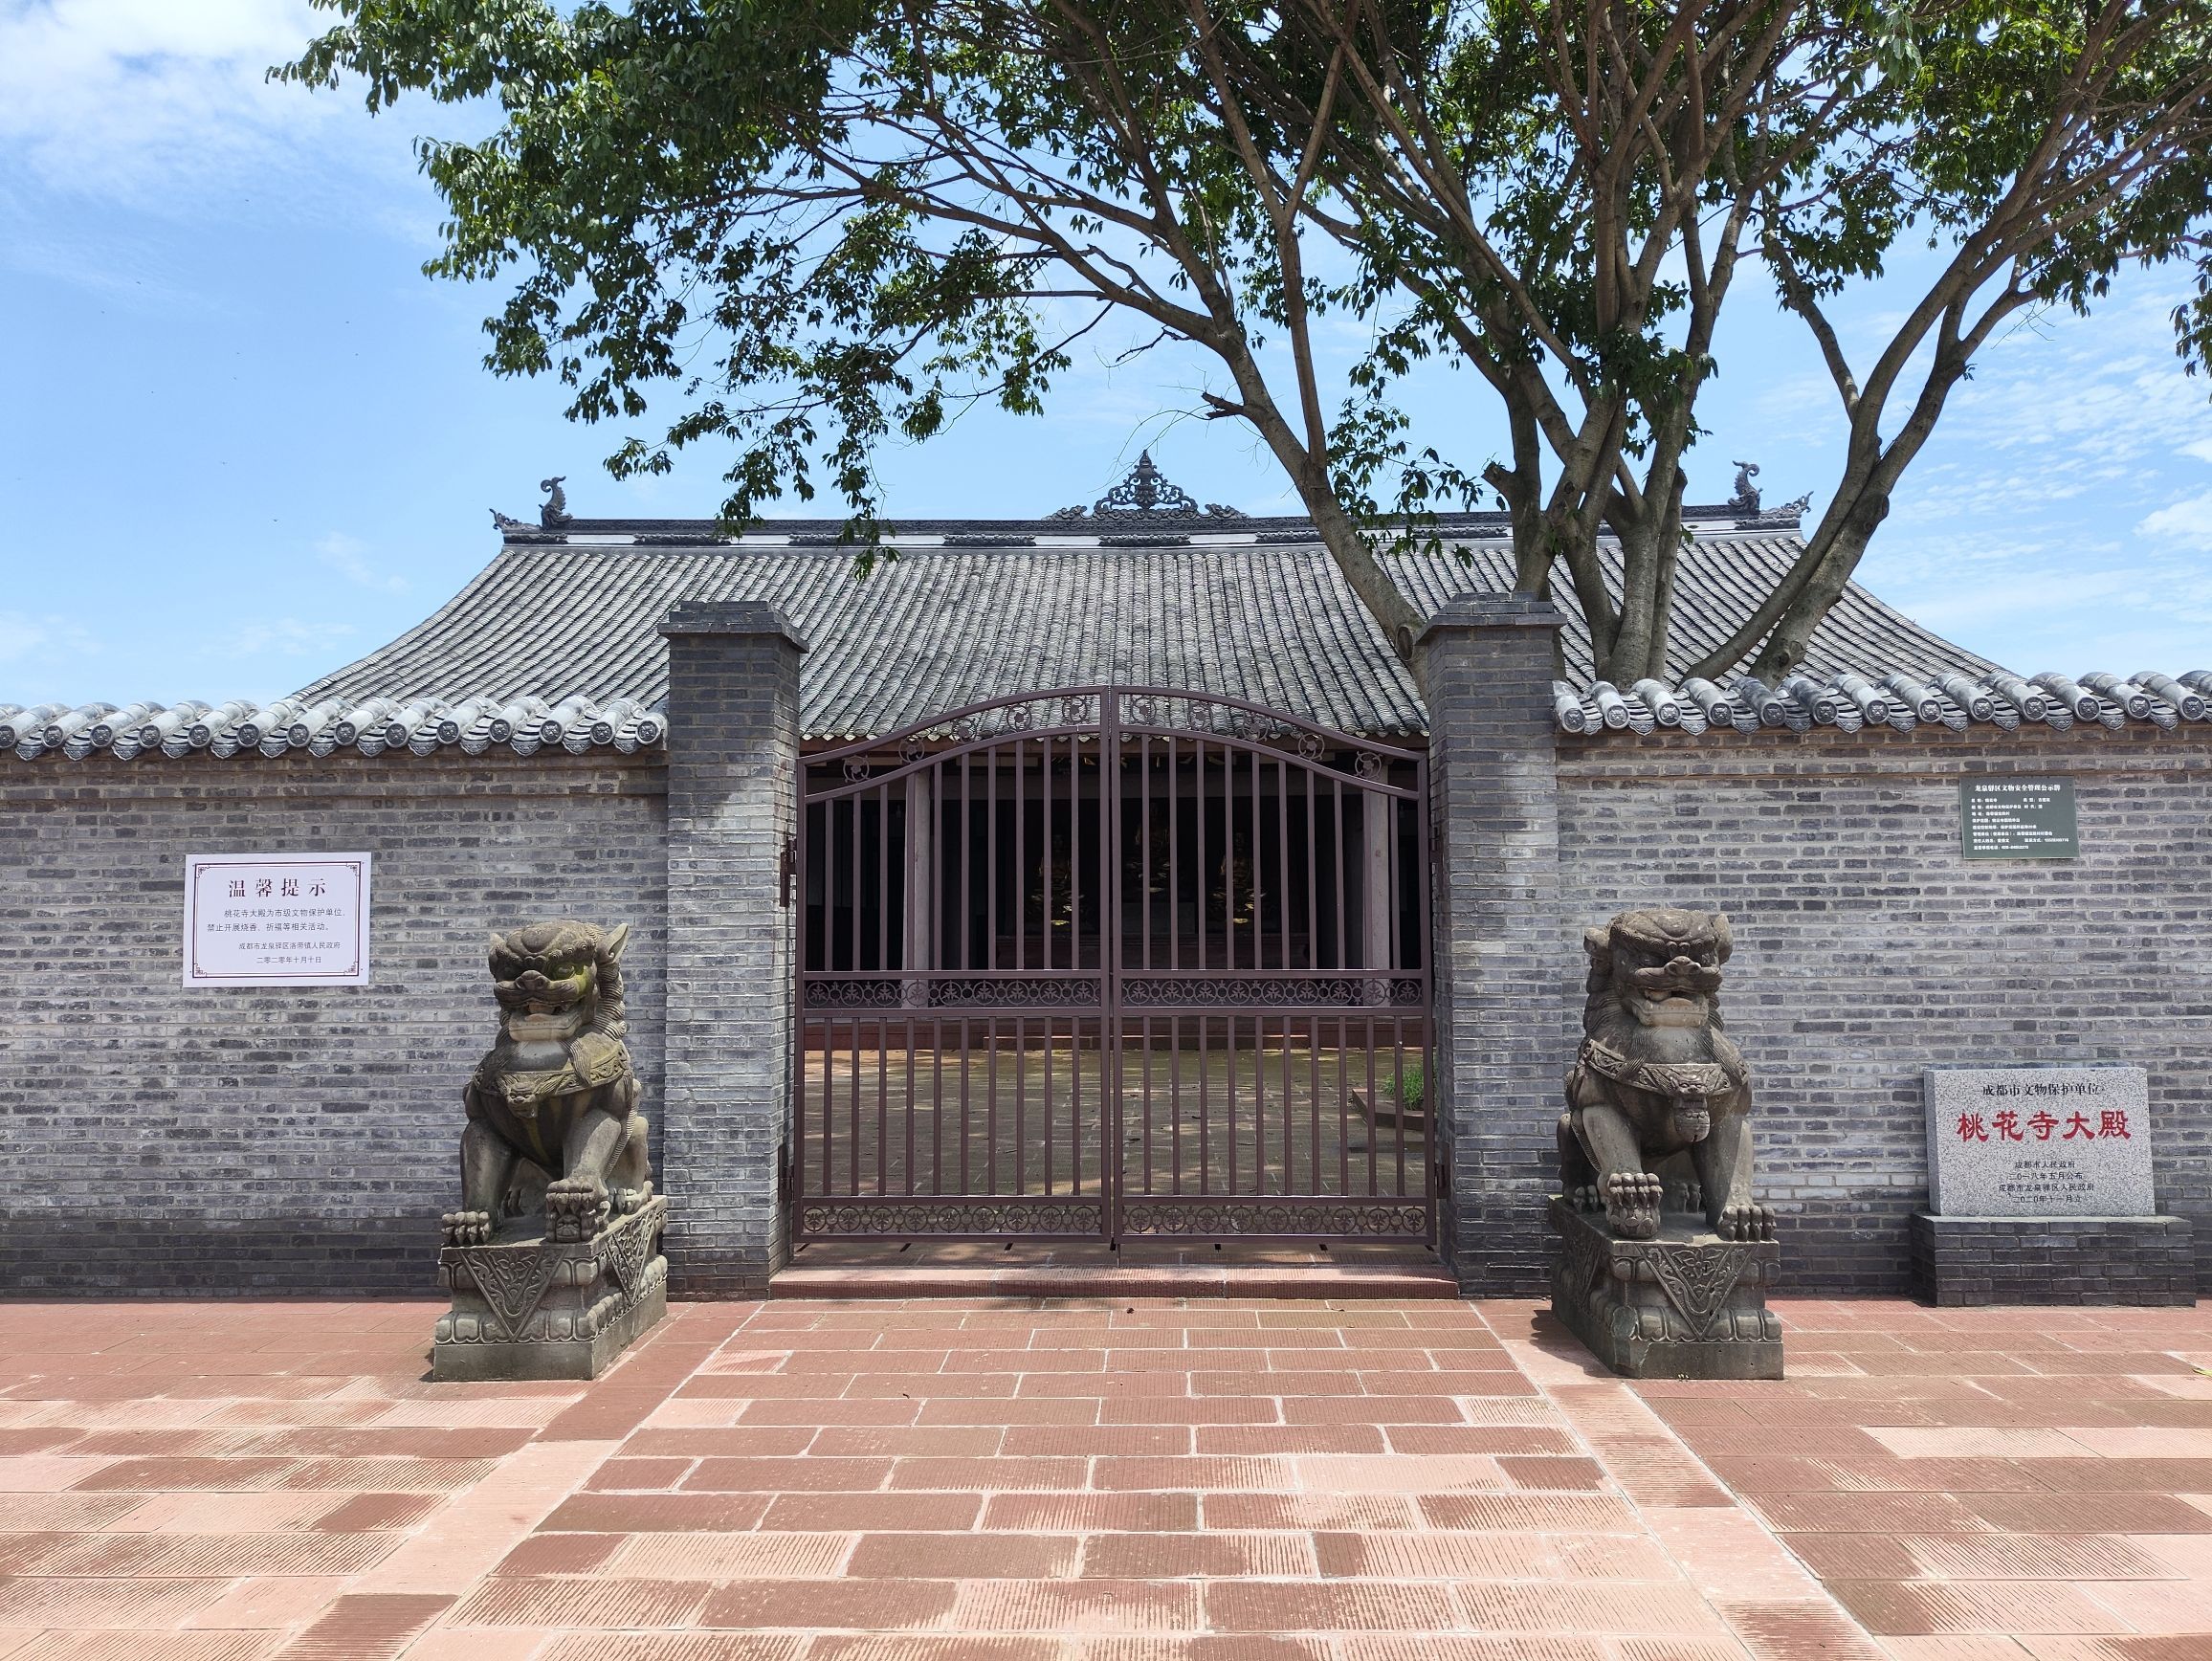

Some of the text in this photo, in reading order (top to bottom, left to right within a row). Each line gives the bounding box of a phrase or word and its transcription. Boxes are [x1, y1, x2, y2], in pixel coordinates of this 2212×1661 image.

[229, 878, 326, 897] 温馨提示
[238, 941, 341, 950] 成都市龙泉驿区洛带镇人民政府
[1982, 1082, 2100, 1096] 成都市文物保护单位
[1957, 1110, 2132, 1141] 桃花寺大殿
[2015, 1161, 2075, 1169] 成都市人民政府
[1999, 1184, 2094, 1192] 成都市龙泉驿区人民政府
